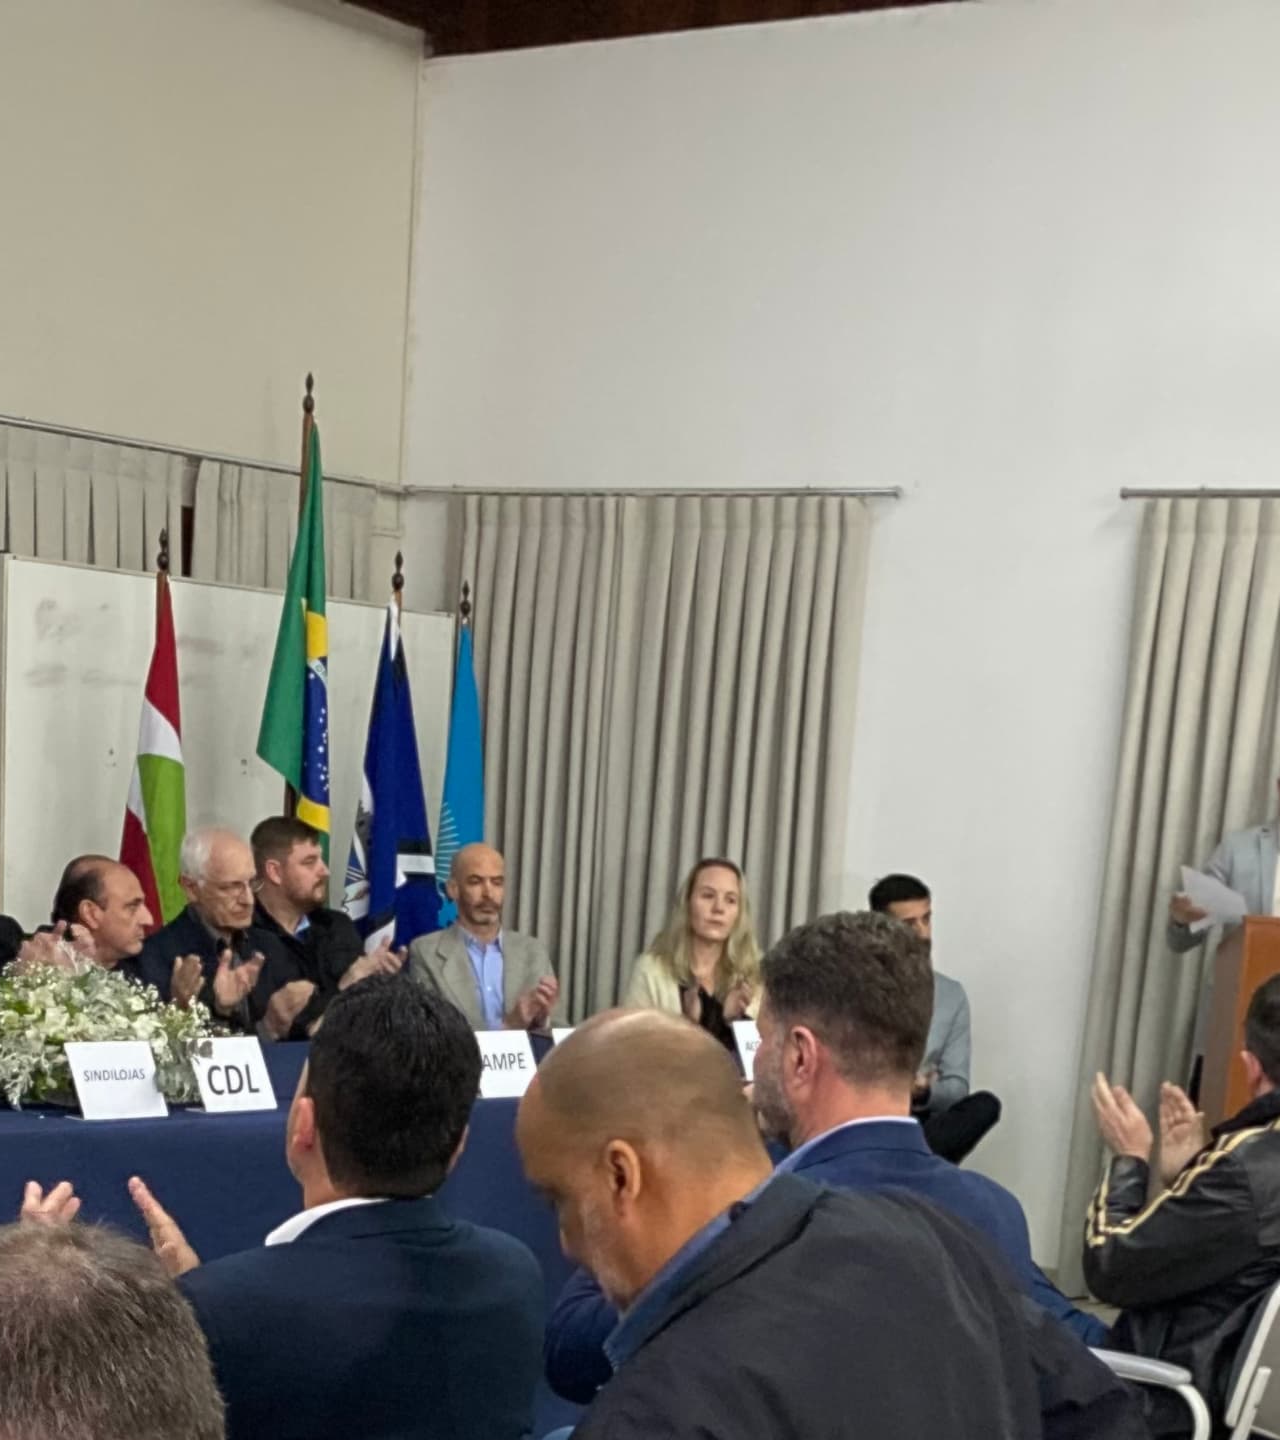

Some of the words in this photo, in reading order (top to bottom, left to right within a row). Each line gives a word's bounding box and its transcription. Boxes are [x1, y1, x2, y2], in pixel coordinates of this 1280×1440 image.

[482, 1052, 526, 1071] AMPE
[83, 1067, 147, 1083] SINDILOJAS
[206, 1064, 261, 1096] CDL
